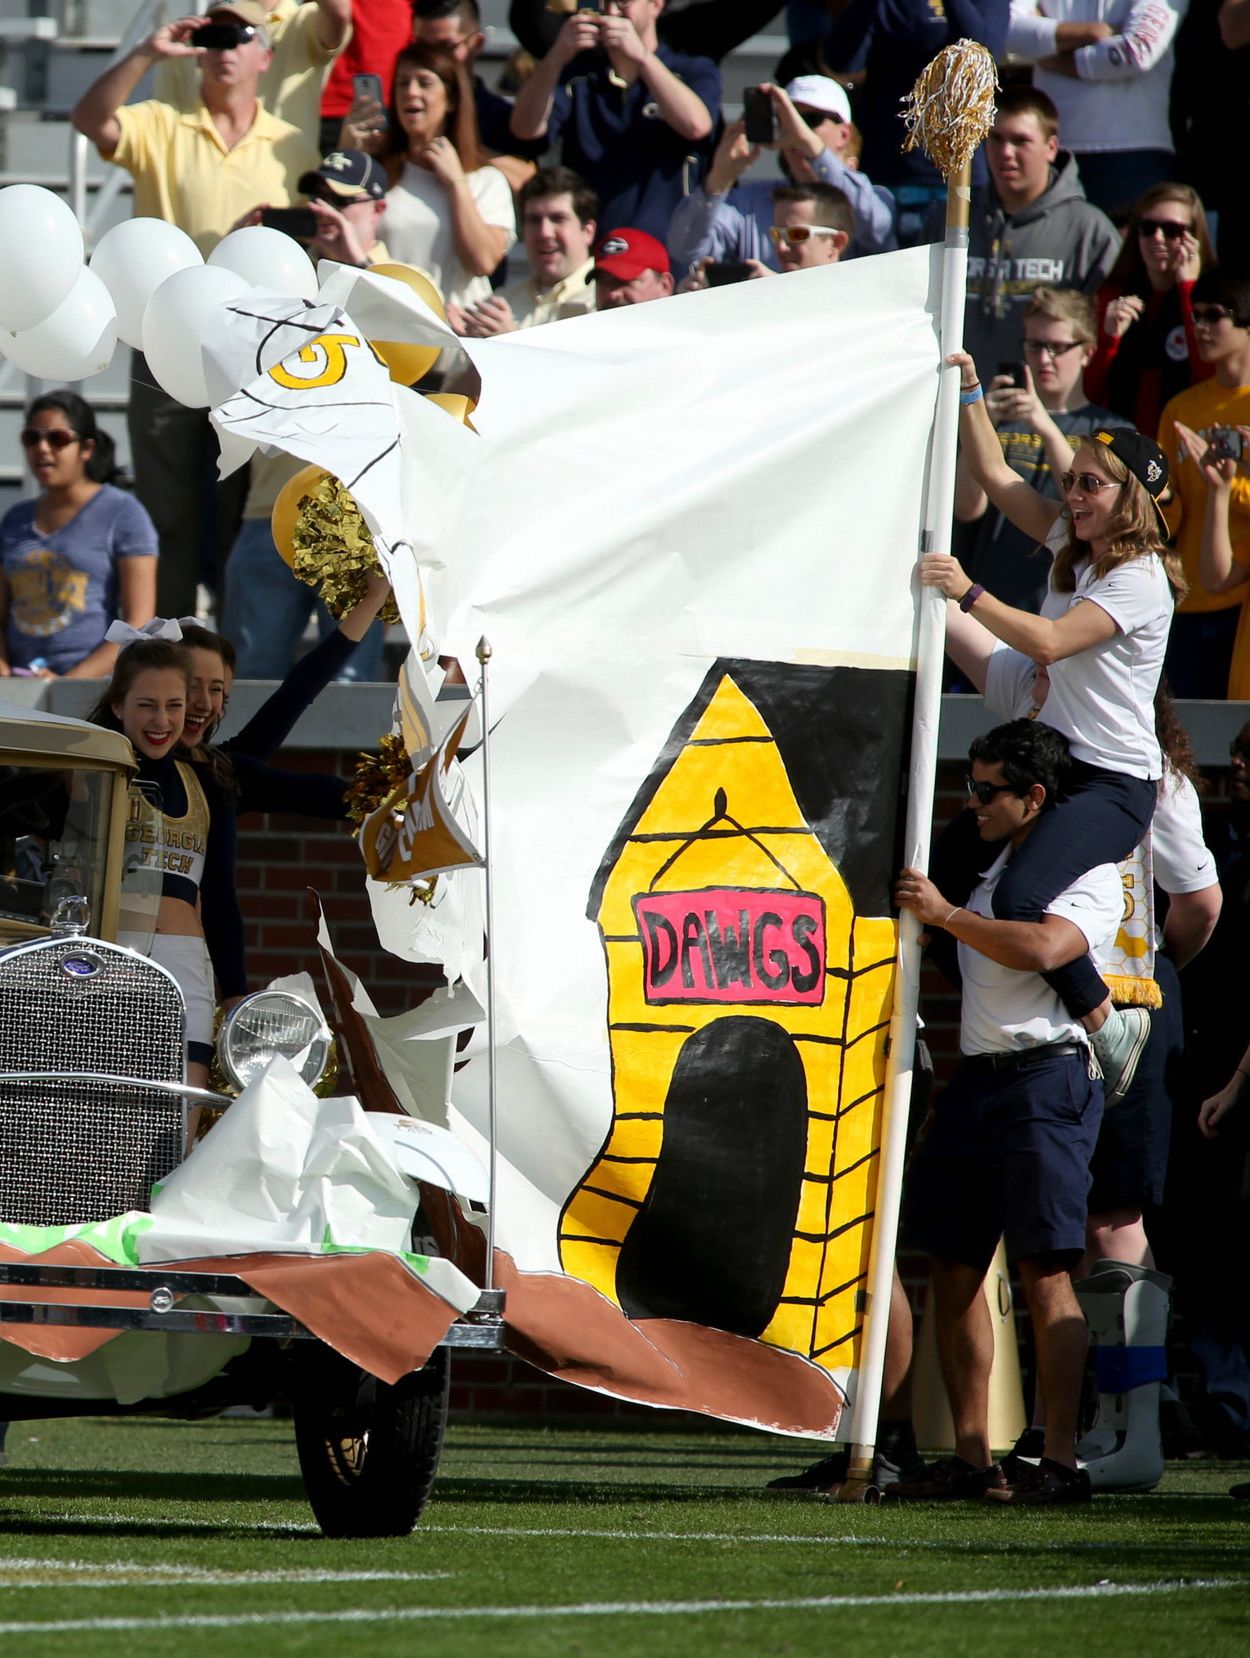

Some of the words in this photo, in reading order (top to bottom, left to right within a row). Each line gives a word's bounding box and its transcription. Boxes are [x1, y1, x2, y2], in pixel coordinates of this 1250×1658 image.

[1015, 258, 1064, 281] TECH
[125, 824, 205, 857] GEORGIA
[141, 846, 194, 875] TECH
[643, 909, 821, 993] DAWGS
